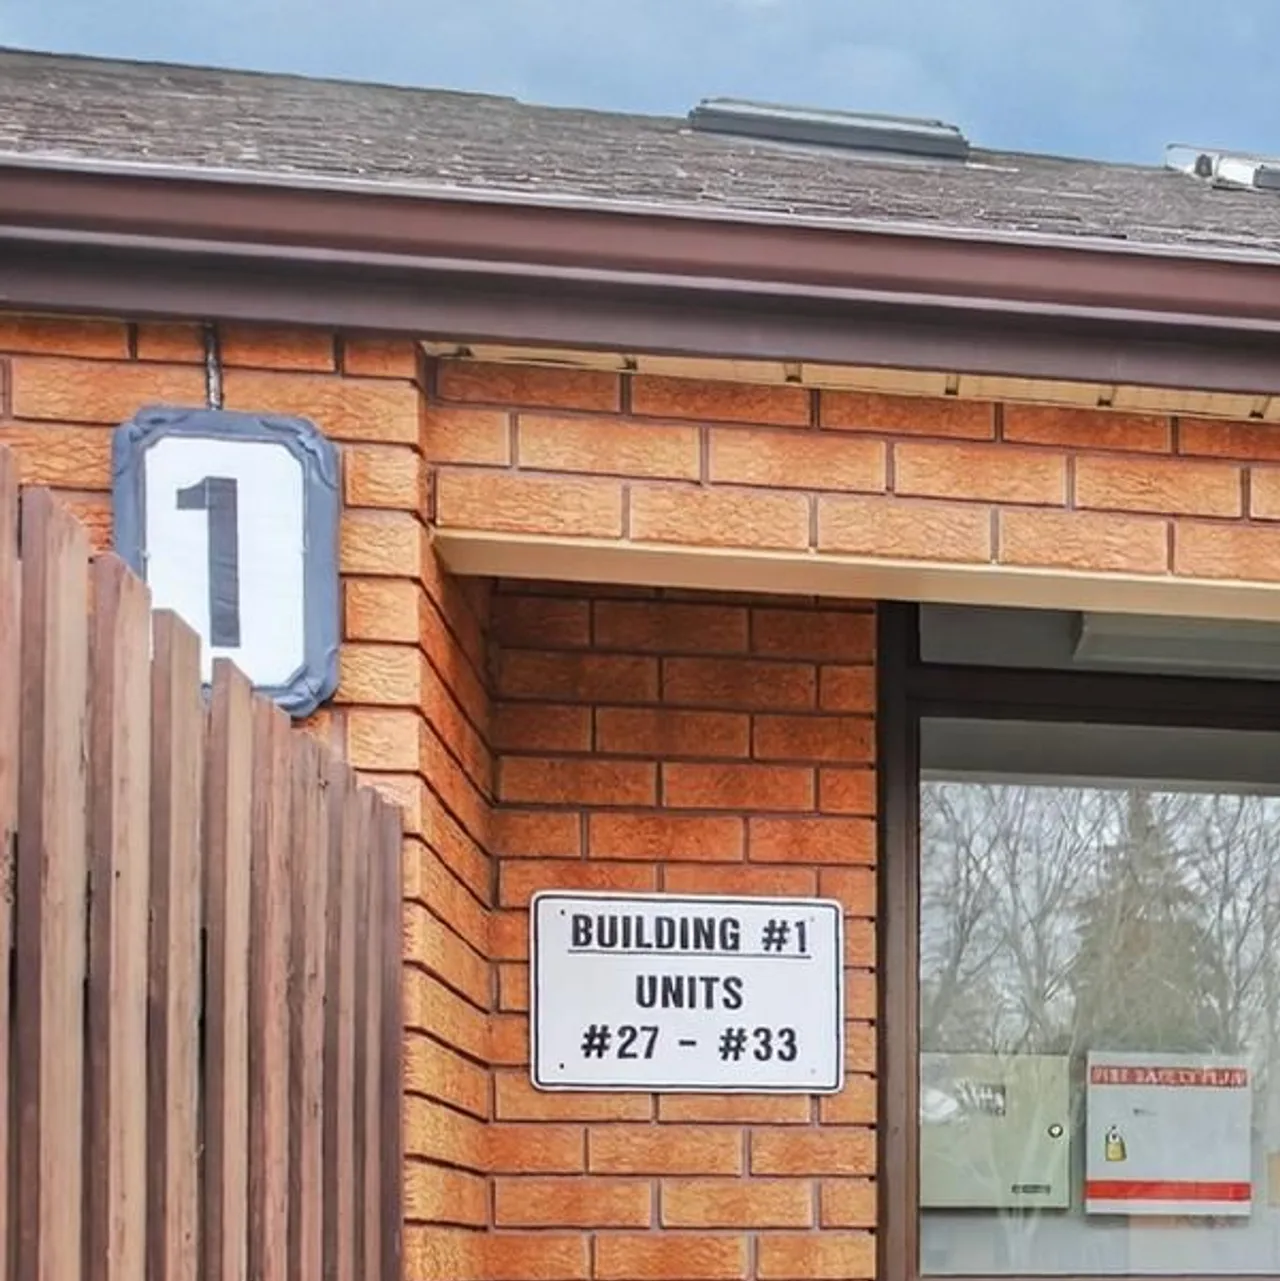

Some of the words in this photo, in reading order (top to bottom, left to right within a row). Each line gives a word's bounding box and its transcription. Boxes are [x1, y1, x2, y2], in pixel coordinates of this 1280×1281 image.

[176, 475, 241, 648] 1
[571, 913, 741, 952] BUILDING
[761, 918, 808, 953] #1
[635, 974, 744, 1010] UNITS
[581, 1023, 660, 1060] #27
[718, 1026, 799, 1063] #33
